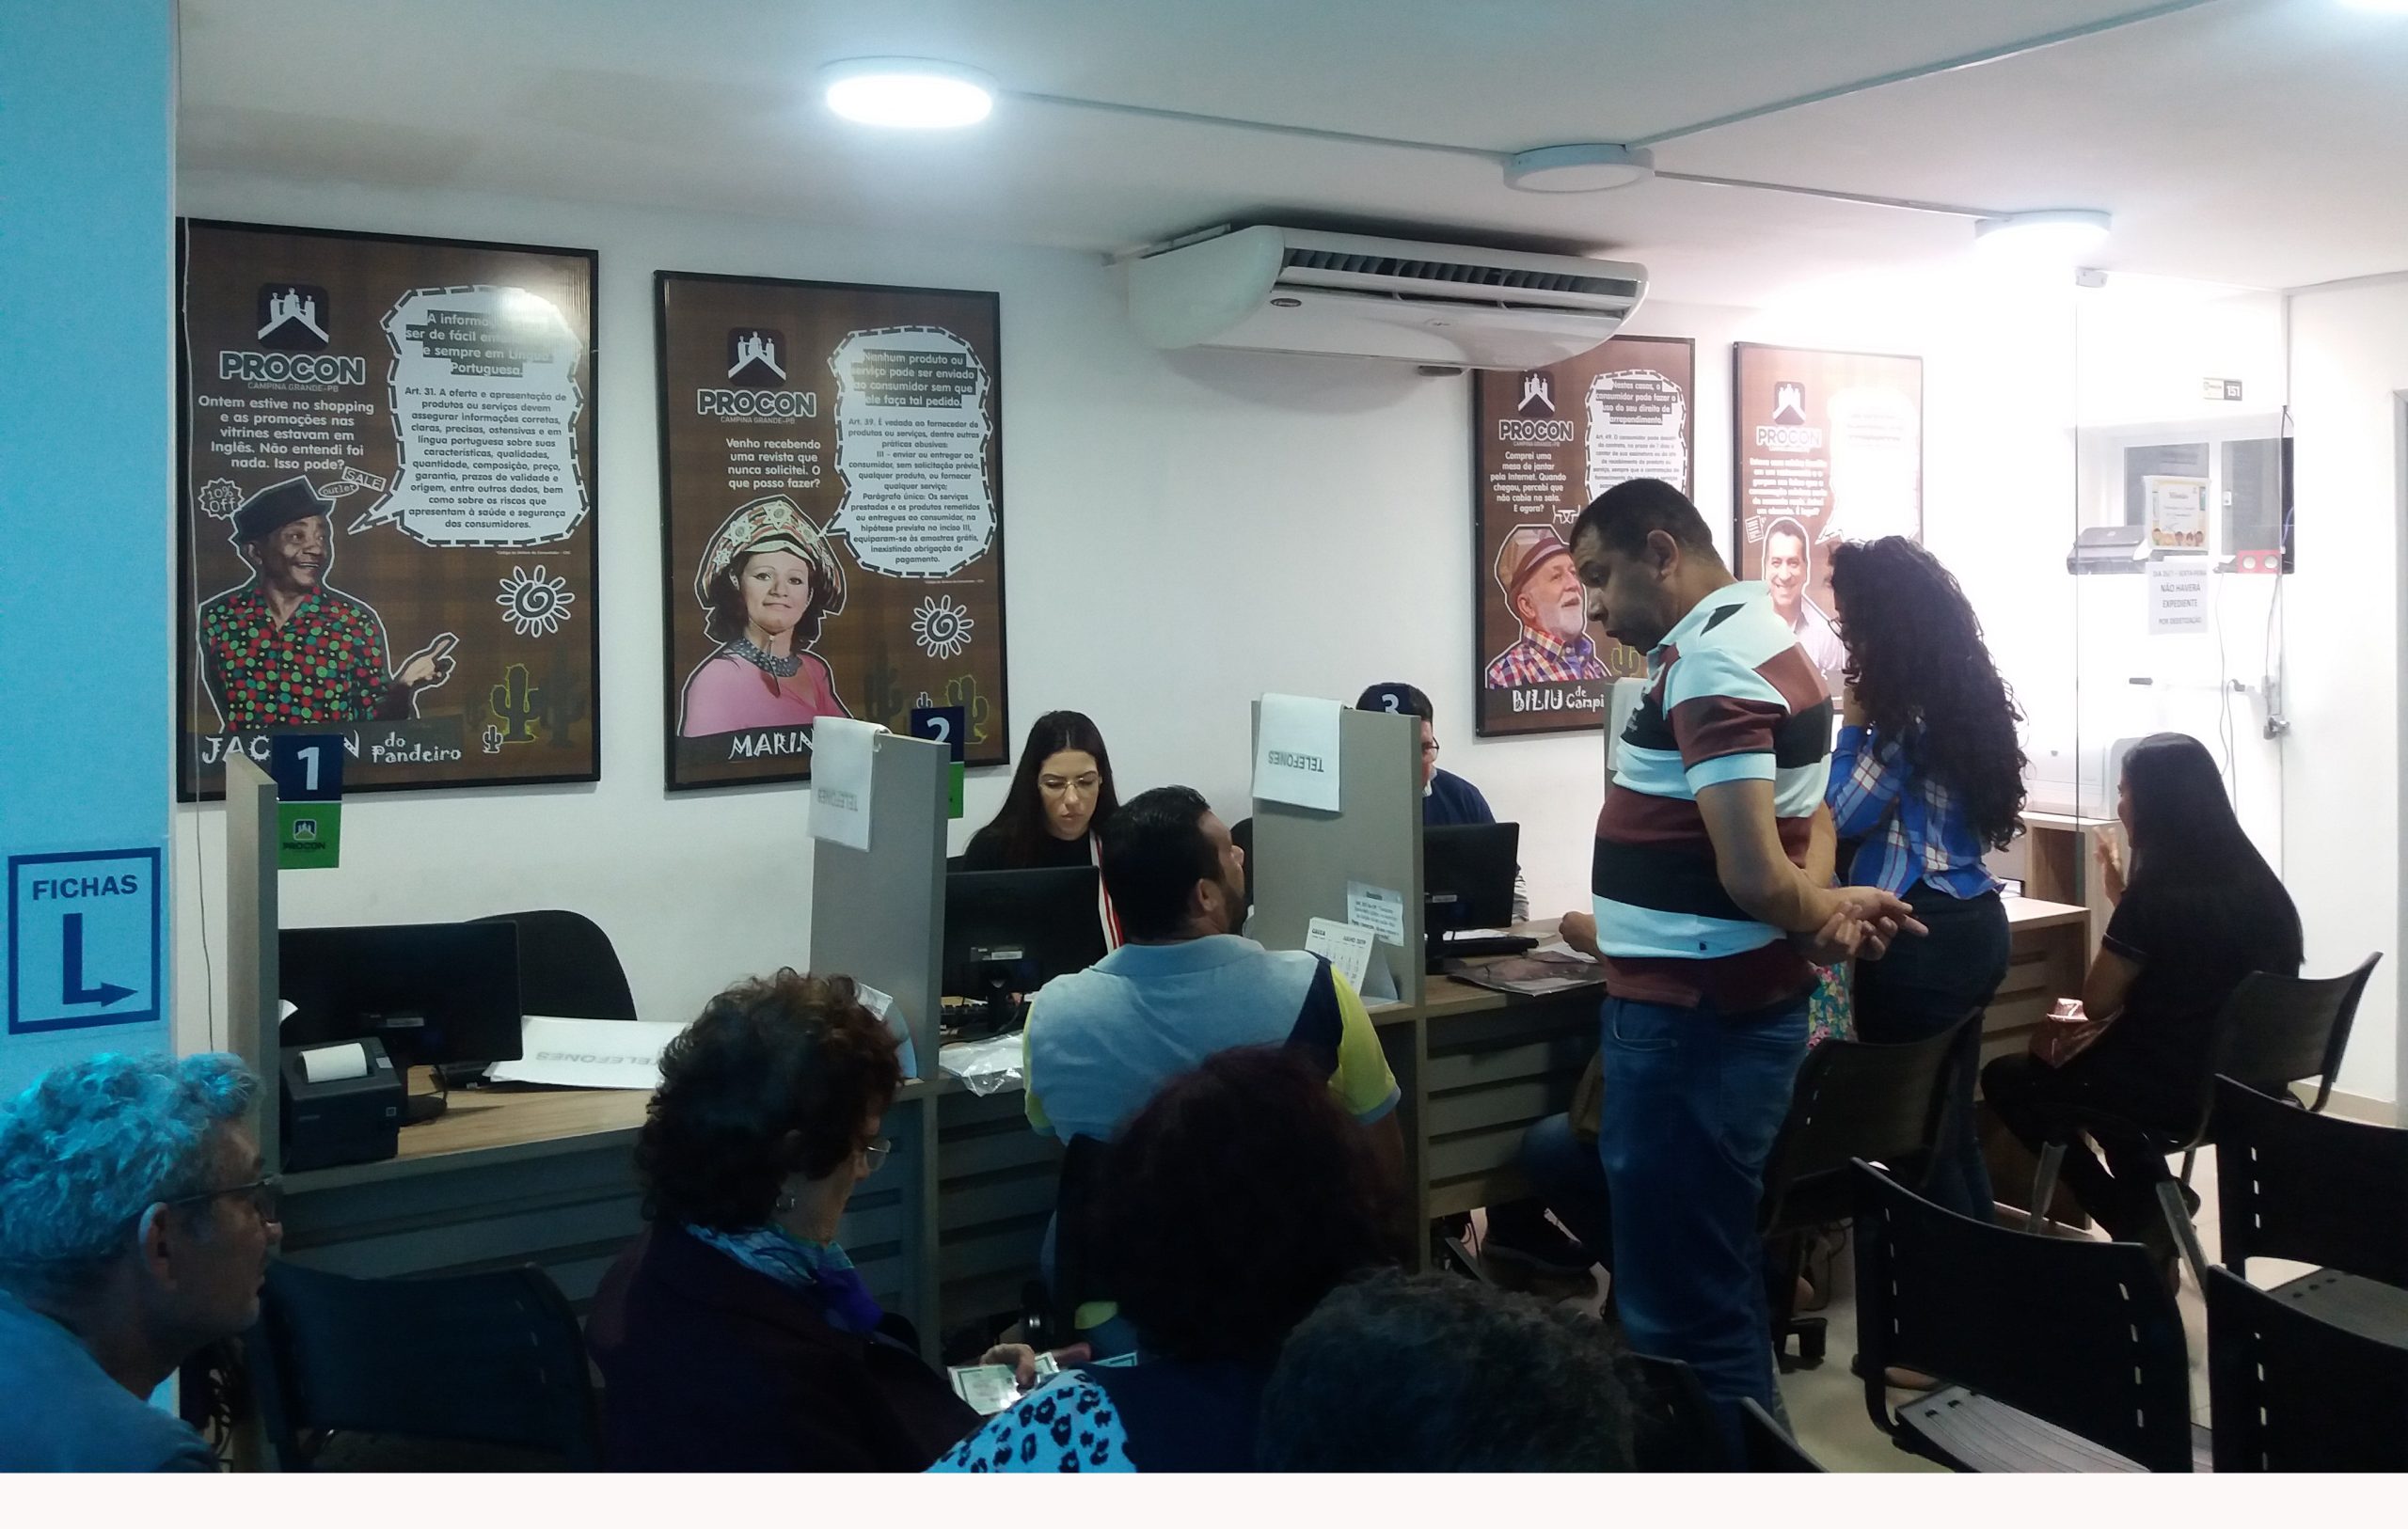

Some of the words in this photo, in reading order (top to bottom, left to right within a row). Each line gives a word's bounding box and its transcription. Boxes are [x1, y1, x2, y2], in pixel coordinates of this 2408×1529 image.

[428, 313, 436, 323] A
[440, 313, 489, 326] informa
[406, 330, 425, 339] ser
[430, 329, 444, 339] de
[450, 330, 476, 341] fácil
[423, 347, 431, 355] e
[435, 348, 481, 358] sempre
[910, 355, 947, 365] produto
[219, 351, 365, 386] PROCON
[890, 368, 914, 379] pode
[936, 370, 974, 379] enviado
[248, 382, 286, 390] CAMPINA
[289, 384, 339, 392] GRANDE-PB
[870, 382, 927, 391] consumidor
[955, 386, 973, 395] que
[450, 388, 477, 397] oferta
[489, 391, 551, 401] apresentação
[198, 395, 245, 407] Ontem
[249, 398, 288, 409] estive
[293, 401, 309, 410] no
[314, 400, 373, 415] shopping
[422, 400, 463, 409] produtos
[482, 402, 517, 412] serviços
[521, 403, 550, 412] devem
[697, 389, 816, 418] PROCON
[884, 396, 906, 405] faça
[910, 396, 922, 405] tal
[927, 397, 961, 407] pedido.
[233, 414, 248, 422] as
[254, 414, 326, 427] promoções
[332, 418, 355, 426] nas
[412, 413, 458, 422] assegurar
[462, 413, 518, 423] informações
[522, 416, 561, 425] corretas,
[220, 427, 269, 438] vitrines
[274, 430, 329, 440] estavam
[334, 432, 354, 440] em
[411, 423, 442, 433] claras,
[446, 425, 485, 435] precisas,
[489, 426, 535, 434] ostensivas
[1499, 419, 1574, 441] PROCON
[419, 435, 447, 445] língua
[452, 437, 503, 447] portuguesa
[507, 438, 532, 447] sobre
[726, 438, 760, 448] Venho
[764, 439, 820, 449] recebendo
[1756, 425, 1822, 449] PROCON
[211, 441, 255, 455] Inglês.
[260, 443, 287, 454] Não
[293, 444, 342, 455] entendi
[347, 445, 363, 456] foi
[424, 449, 493, 458] características,
[497, 450, 549, 459] qualidades,
[758, 451, 794, 462] revista
[798, 453, 817, 464] que
[1505, 451, 1534, 461] Comprei
[231, 457, 269, 468] nada.
[275, 458, 299, 468] Isso
[304, 459, 344, 471] pode?
[413, 460, 469, 469] quantidade,
[473, 462, 530, 471] composição,
[728, 466, 761, 475] nunca
[765, 465, 808, 475] solicitei.
[812, 465, 820, 475] O
[1534, 462, 1555, 472] jantar
[345, 469, 382, 490] SALE
[415, 472, 458, 481] garantia,
[462, 474, 492, 482] prazos
[511, 473, 549, 481] validade
[1490, 473, 1505, 481] pela
[411, 483, 446, 493] origem,
[510, 485, 540, 494] dados,
[544, 485, 562, 494] bem
[729, 480, 749, 490] que
[753, 480, 784, 490] posso
[787, 478, 820, 488] fazer?
[207, 485, 233, 499] 10%
[409, 509, 465, 517] apresentam
[518, 510, 565, 518] segurança
[1520, 504, 1544, 513] agora?
[466, 520, 531, 528] consumidores.
[1576, 686, 1586, 697] de
[1382, 694, 1400, 715] 3
[1513, 688, 1562, 712] BILIU
[1565, 693, 1605, 713] Campi
[927, 717, 951, 744] 2
[202, 730, 358, 764] JACN
[385, 733, 405, 748] do
[728, 730, 815, 760] MARIN
[372, 743, 461, 763] Pandeiro
[1269, 750, 1324, 773] TELEFONES
[297, 747, 319, 790] 1
[32, 874, 139, 901] FICHAS
